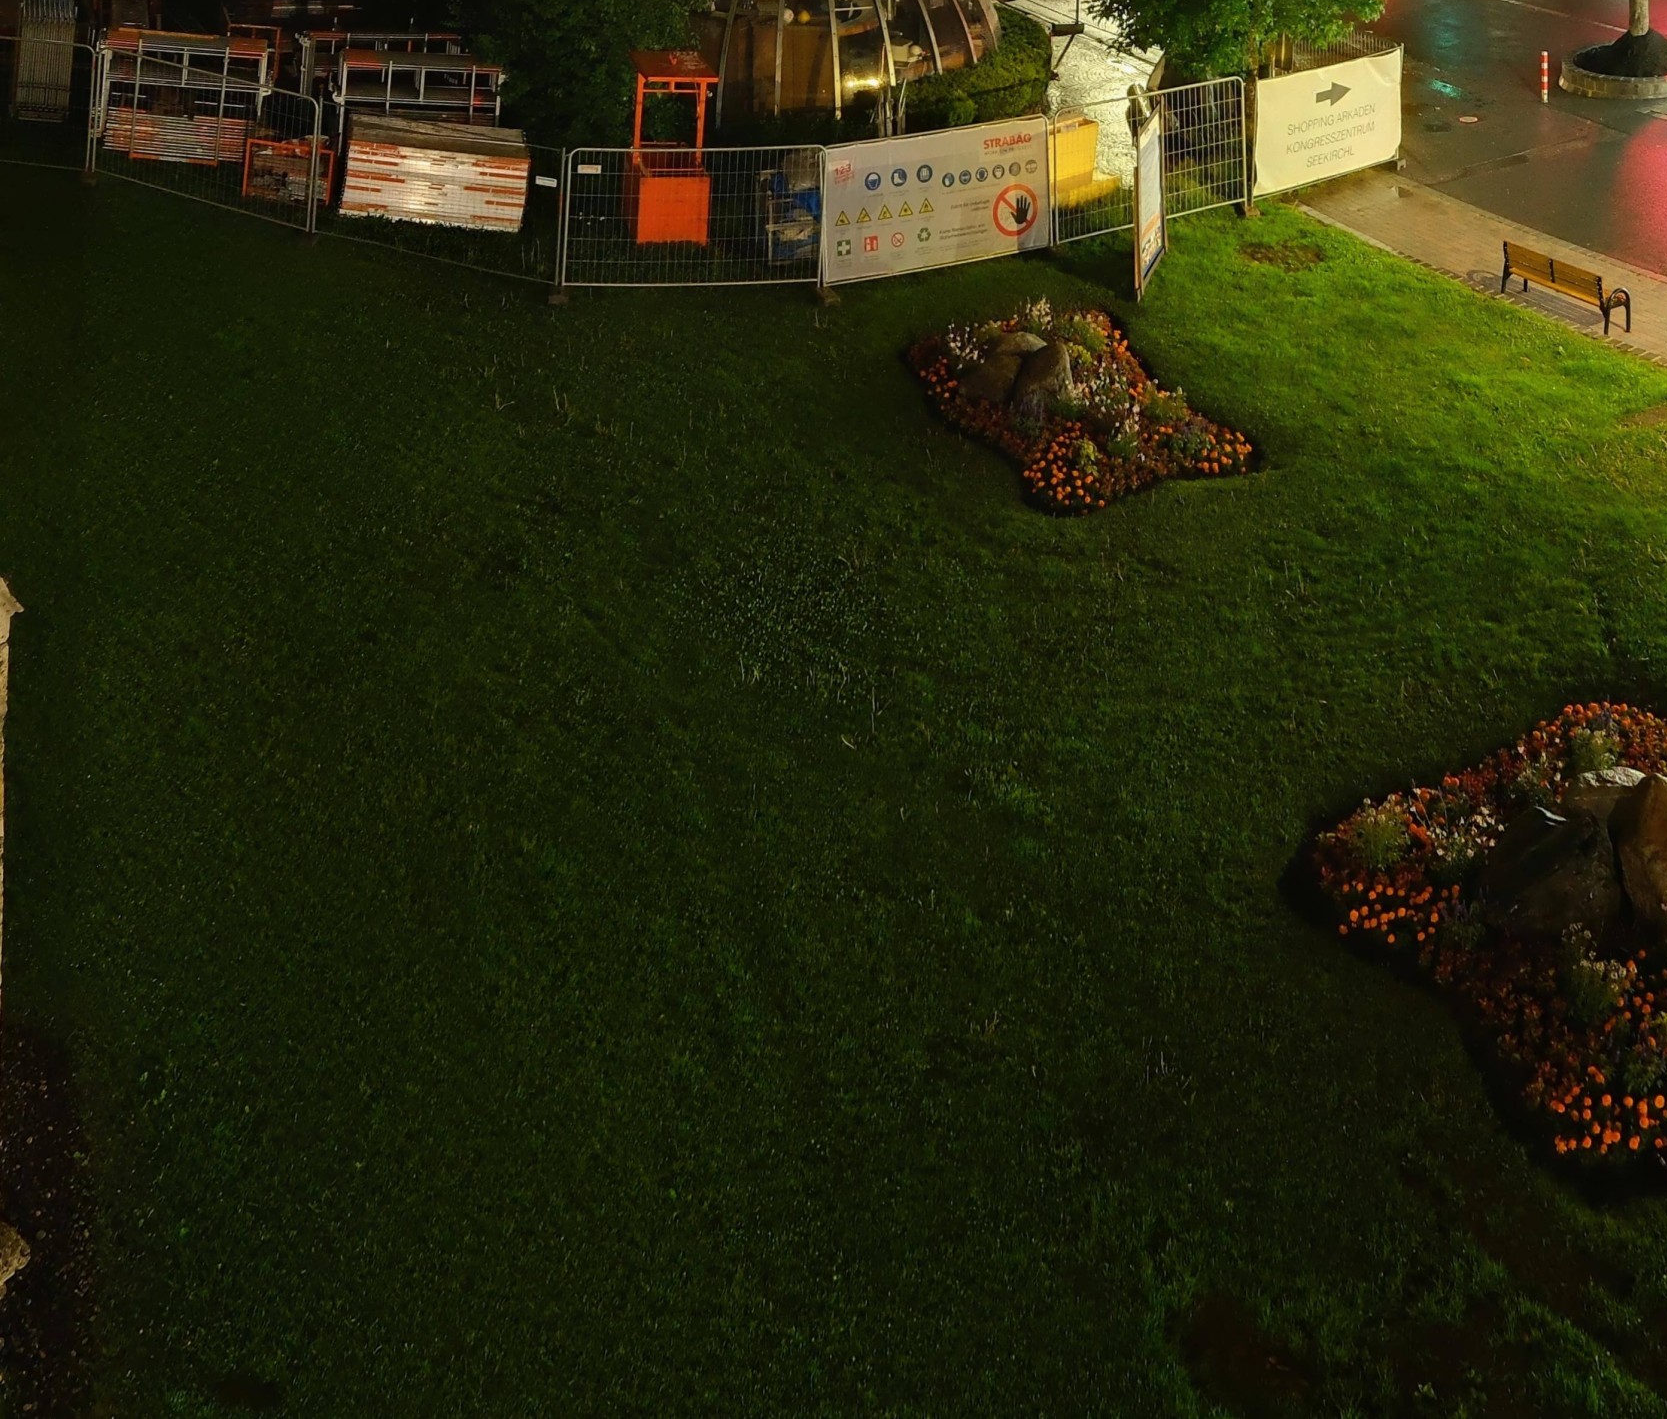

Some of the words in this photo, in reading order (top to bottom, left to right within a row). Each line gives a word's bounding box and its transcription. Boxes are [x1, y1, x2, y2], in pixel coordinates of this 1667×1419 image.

[1287, 113, 1334, 136] SHOPPING
[1337, 103, 1376, 123] ARKADEN
[983, 133, 1032, 150] STRABAG
[1286, 120, 1376, 154] KONGRESSZENTRUM
[1306, 146, 1355, 168] SEEKIRCHL
